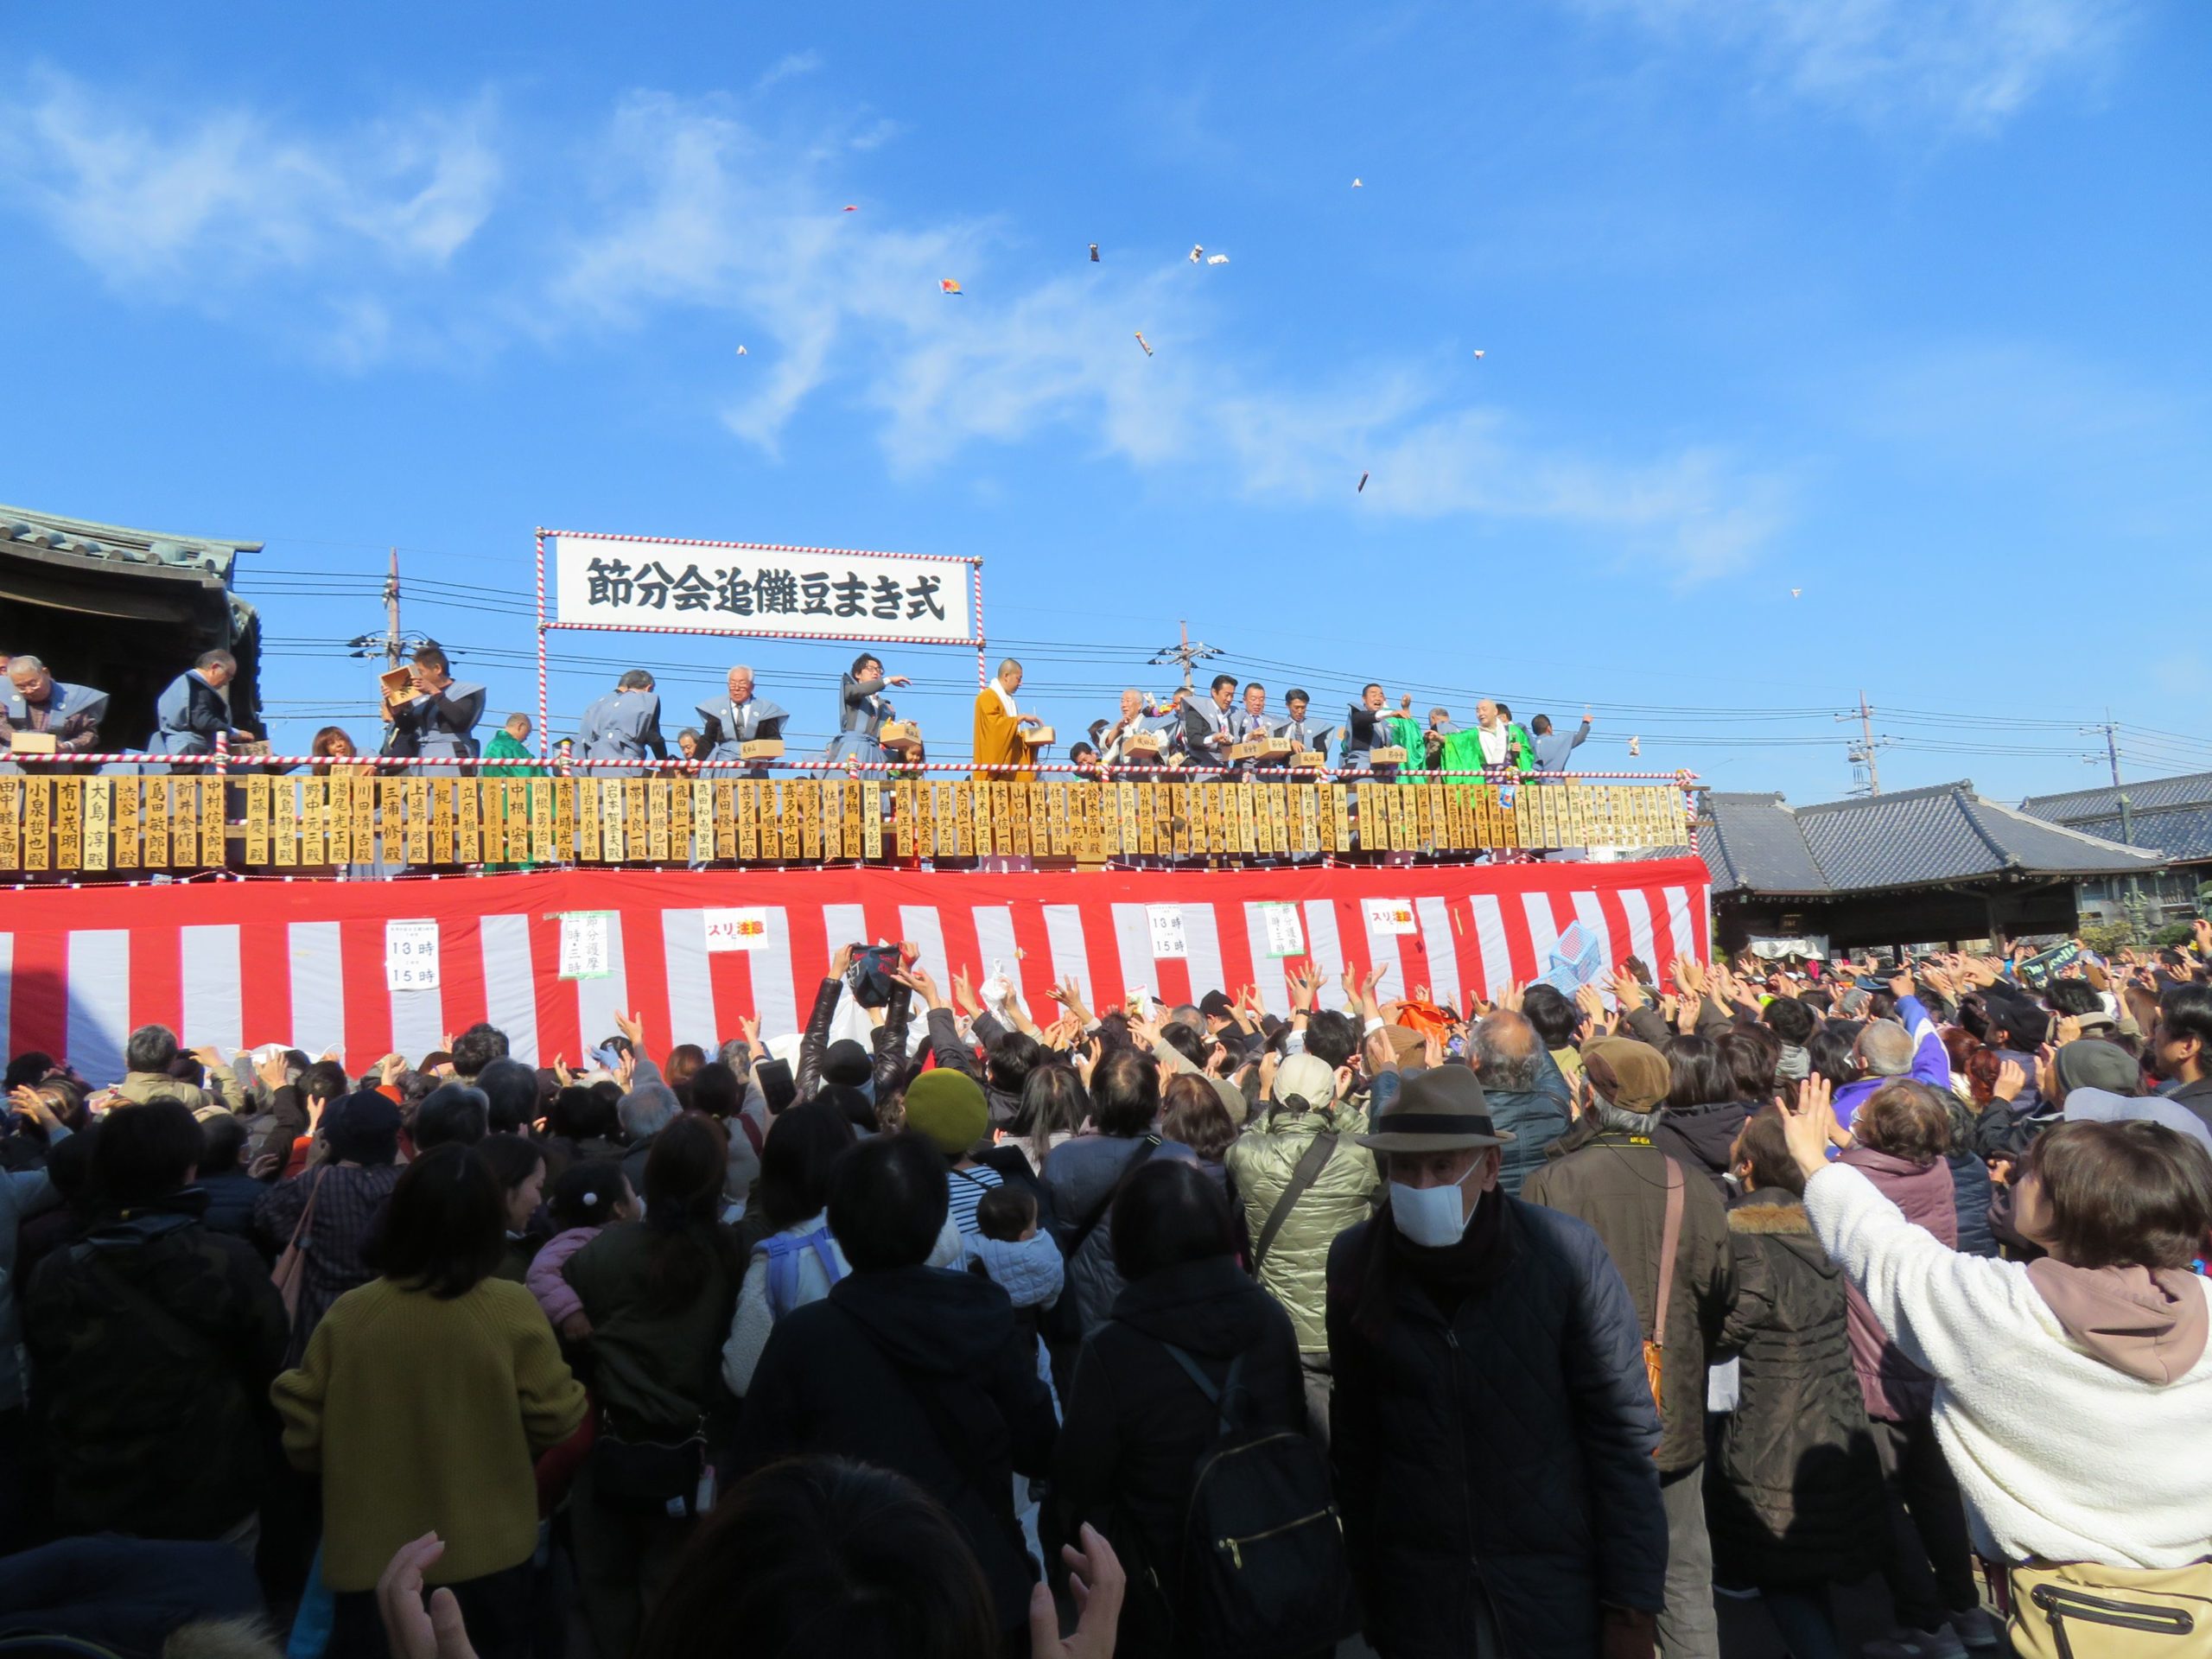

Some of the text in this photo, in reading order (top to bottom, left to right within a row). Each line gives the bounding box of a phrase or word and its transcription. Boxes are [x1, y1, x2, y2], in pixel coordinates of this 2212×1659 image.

[586, 557, 945, 621] 節分会追儺豆まき式
[28, 783, 47, 867] 小泉哲也殿
[60, 781, 79, 867] 有山茂明殿
[148, 782, 167, 864] 島田敏郎殿
[175, 782, 194, 864] 新井金作殿
[305, 784, 321, 861] 野中元三殿
[332, 783, 347, 861] 湯尾光正殿
[462, 787, 477, 861] 立原雅夫殿
[558, 783, 572, 860] 赤熊晴光殿
[629, 786, 645, 857] 帯津良一殿
[674, 785, 689, 857] 飛田和一雄殿
[718, 785, 734, 856] 原田隆一殿
[741, 784, 755, 857] 喜多善正殿
[762, 784, 777, 857] 喜多順子殿
[784, 784, 798, 857] 喜多卓也殿
[805, 785, 818, 857] 喜多みどり殿
[919, 788, 931, 854] 吉野英夫殿
[938, 787, 952, 854] 阿部光志殿
[976, 785, 989, 853] 青木猛正殿
[995, 788, 1011, 854] 本多信一殿
[1320, 790, 1333, 849] 石井成人殿
[393, 941, 435, 957] 13時
[709, 920, 765, 939] スリに注意
[1154, 916, 1181, 930] 13時
[1157, 939, 1184, 952] 15時
[394, 969, 435, 982] 15時
